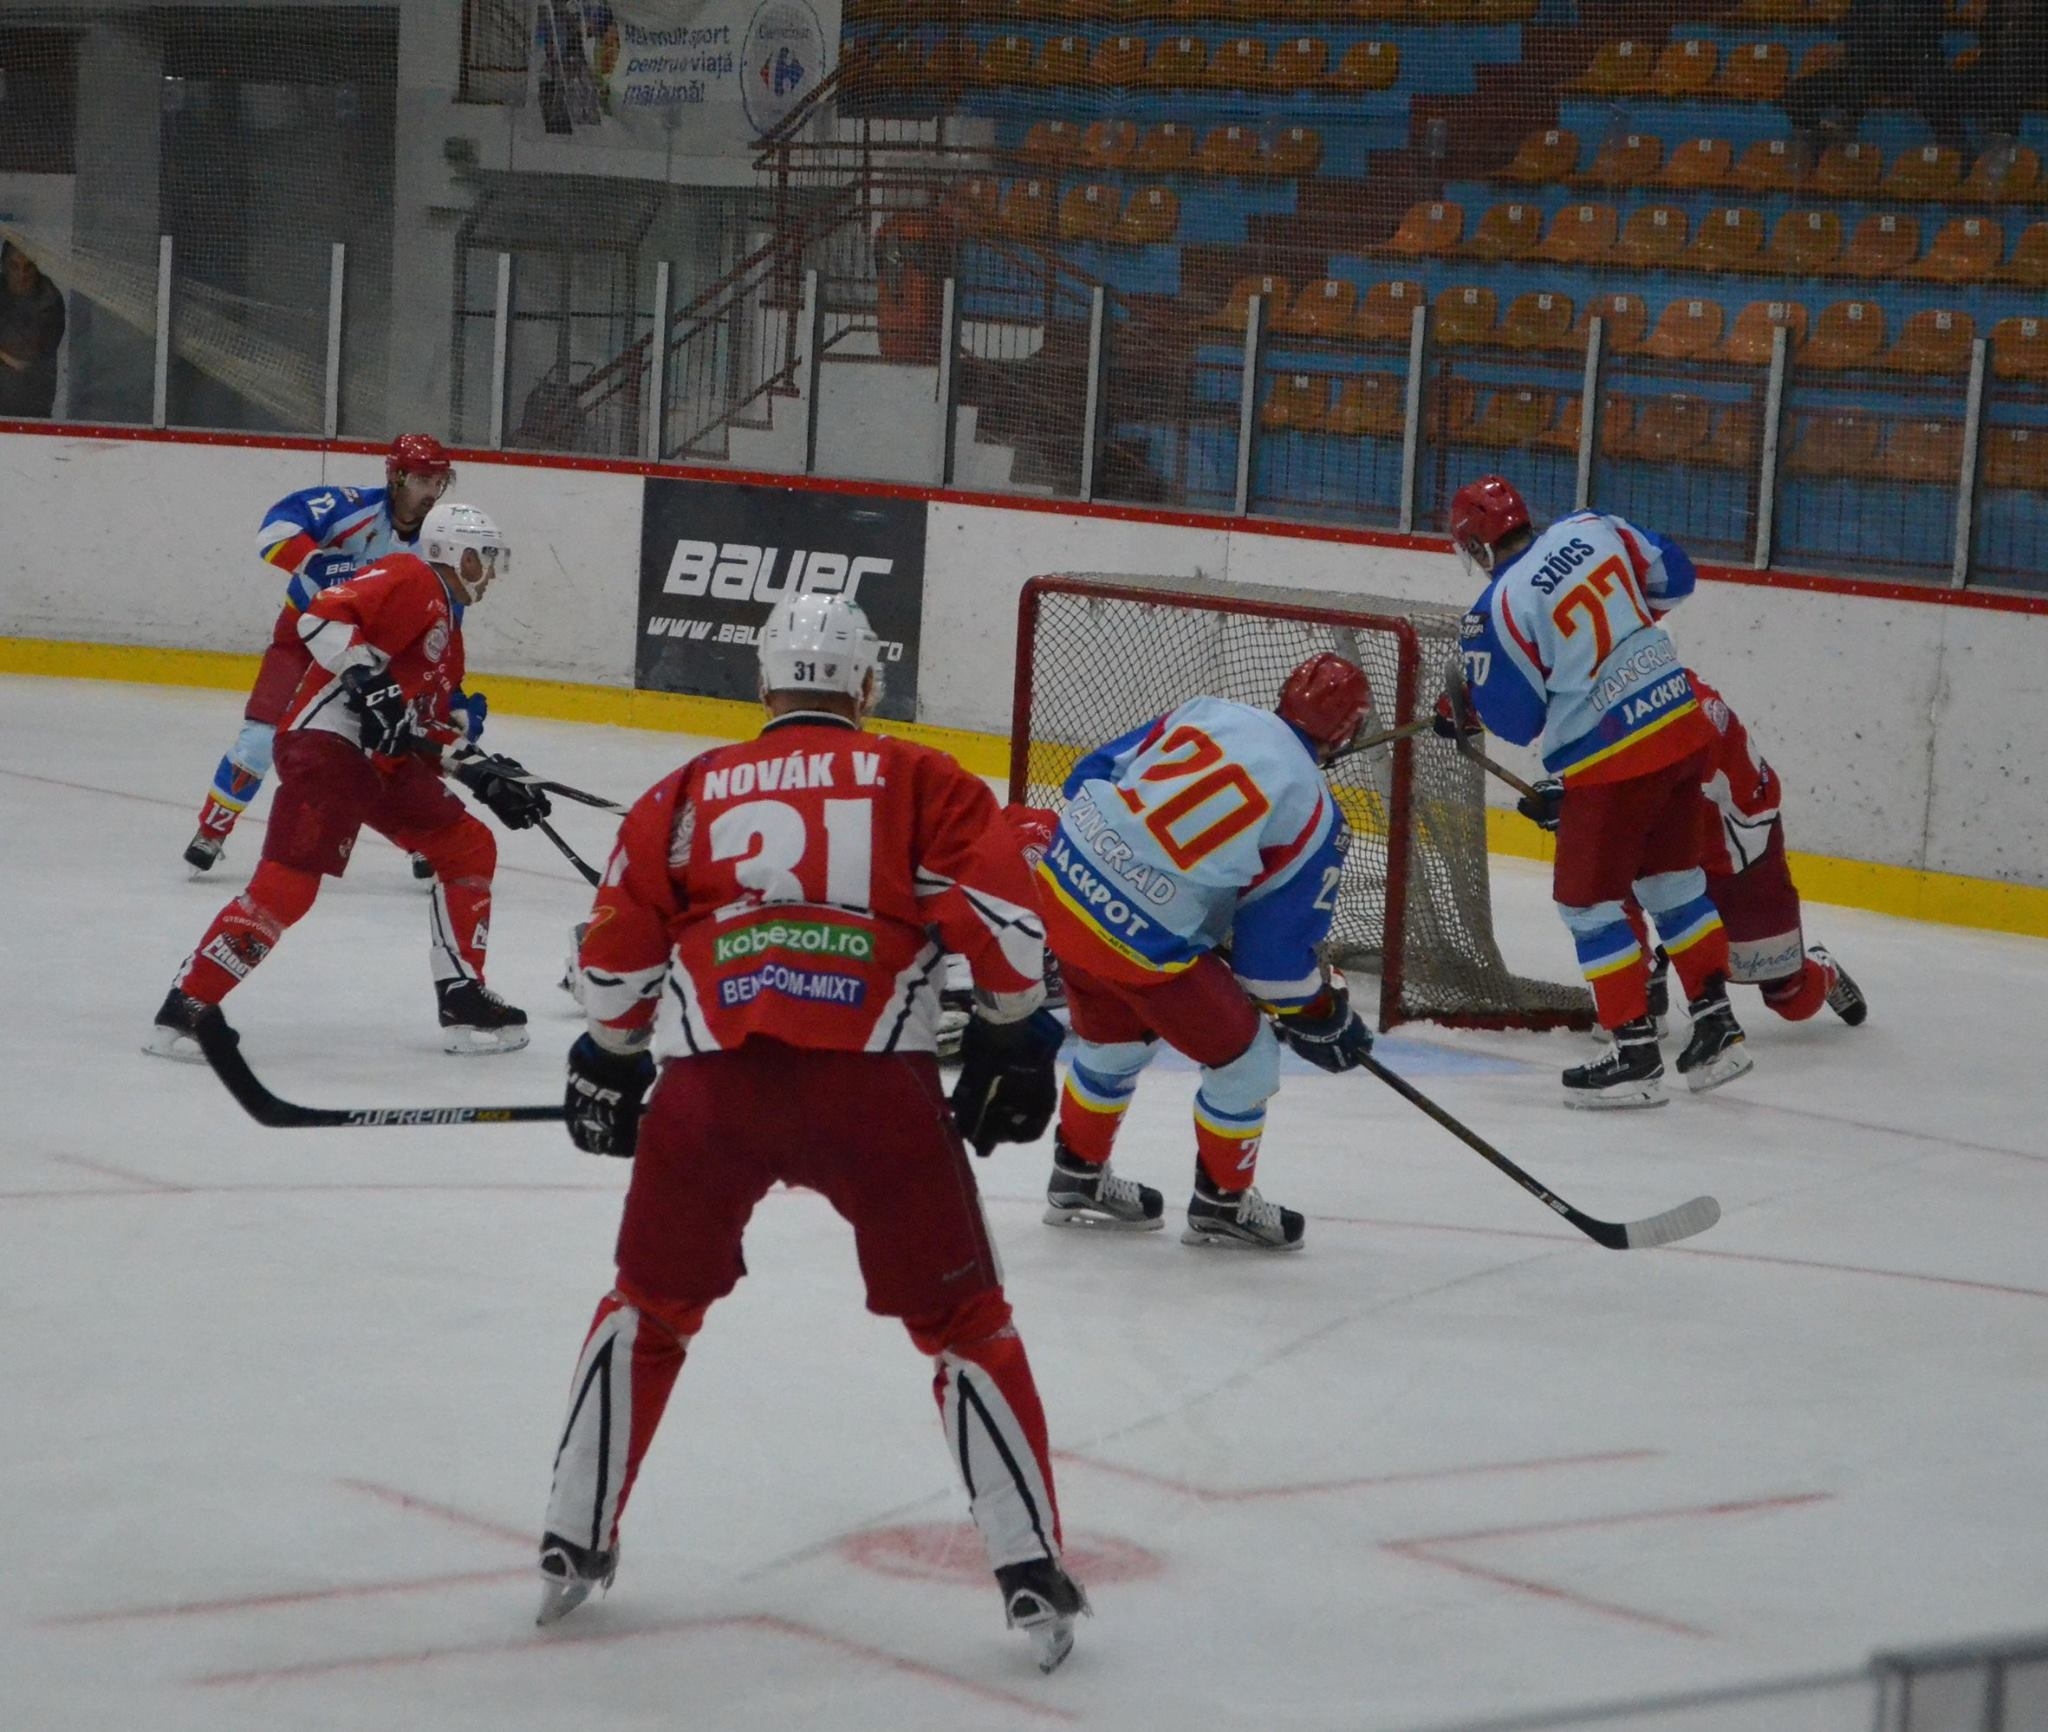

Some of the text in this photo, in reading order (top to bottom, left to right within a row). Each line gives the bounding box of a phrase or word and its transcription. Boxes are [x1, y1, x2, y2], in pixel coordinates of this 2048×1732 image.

[307, 491, 336, 521] 12
[793, 660, 815, 683] 31
[703, 750, 887, 801] NOVÁK V.
[1115, 724, 1270, 872] 20
[205, 802, 236, 832] 12
[709, 799, 873, 910] 31
[1069, 786, 1177, 906] TANCRAD
[1051, 837, 1150, 937] JACKPOT
[716, 925, 869, 961] kobezol.ro
